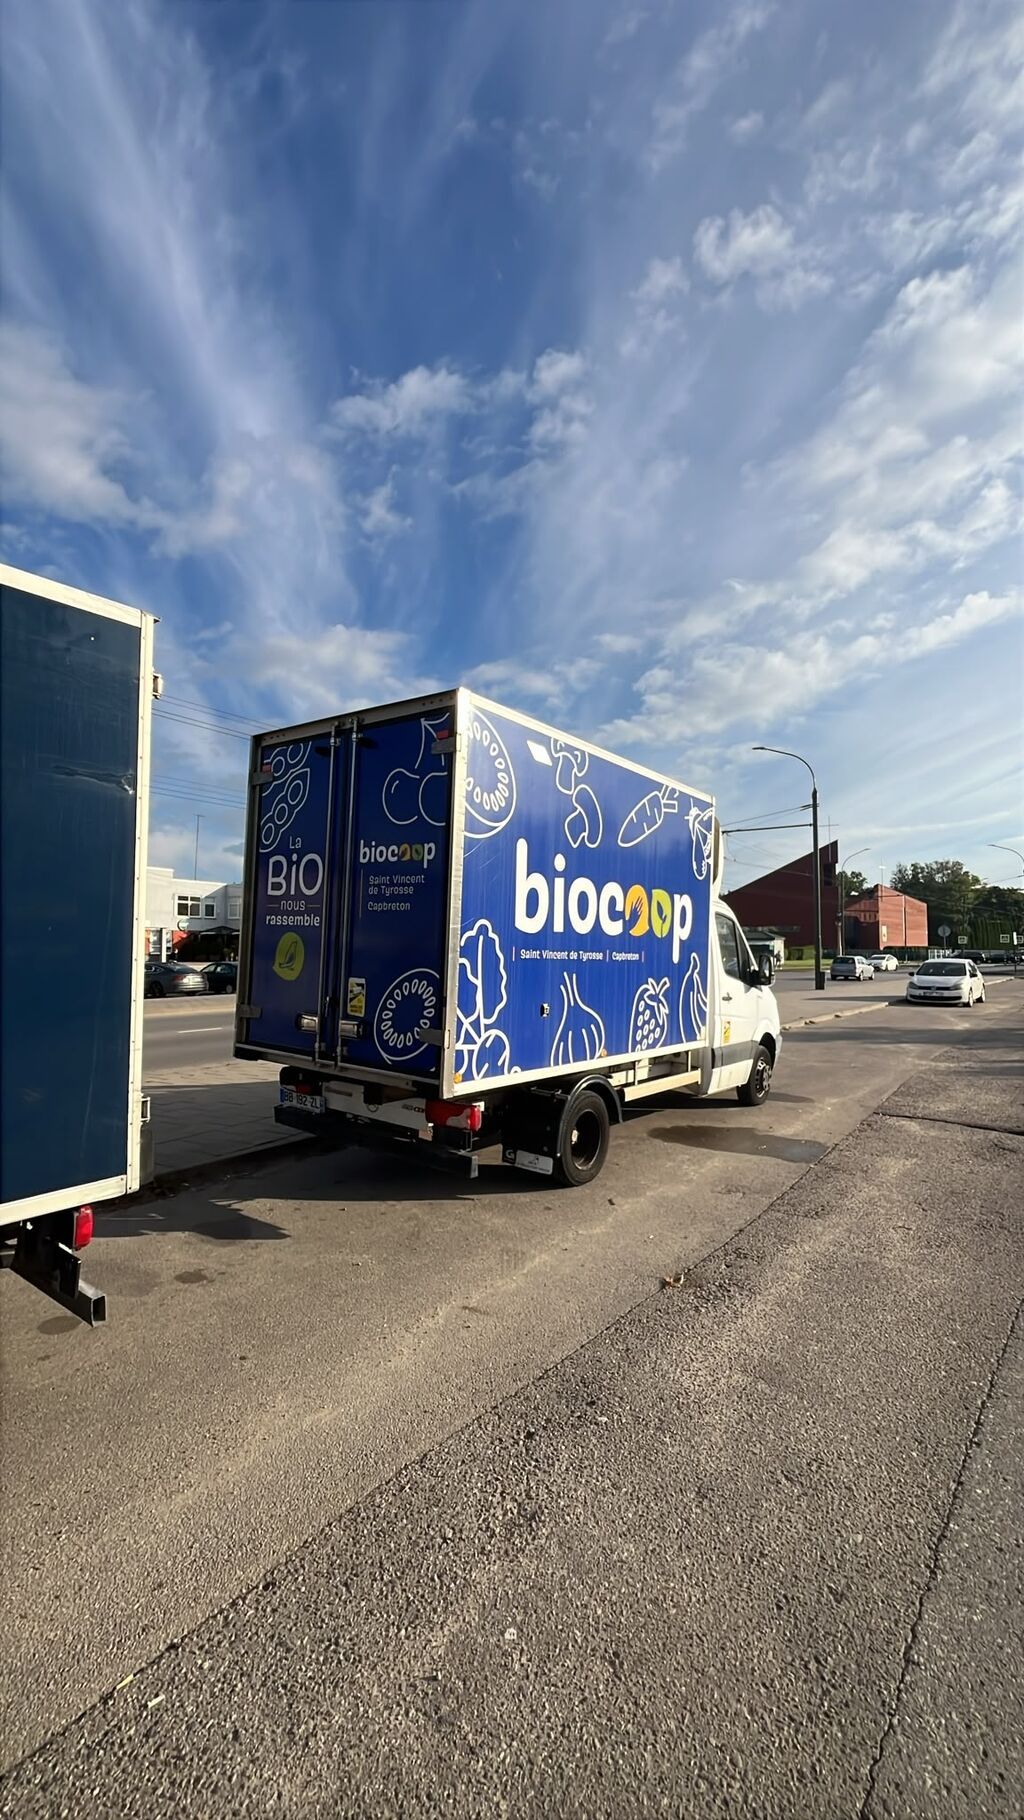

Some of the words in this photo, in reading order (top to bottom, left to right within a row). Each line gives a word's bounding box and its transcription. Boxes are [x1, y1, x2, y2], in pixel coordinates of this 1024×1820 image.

[289, 835, 302, 849] La
[360, 839, 436, 868] biocoop
[369, 874, 391, 885] Saint
[392, 874, 425, 884] Vincent
[368, 886, 379, 895] de
[380, 885, 414, 897] Tyrosse
[280, 900, 306, 911] nous
[367, 901, 411, 912] Capbreton
[515, 838, 693, 964] biocoop
[265, 914, 321, 926] rassemble
[520, 949, 541, 960] Saint
[541, 949, 569, 960] Vincent
[569, 950, 578, 960] de
[579, 950, 604, 962] Tyrosse
[612, 951, 640, 962] Capbreton
